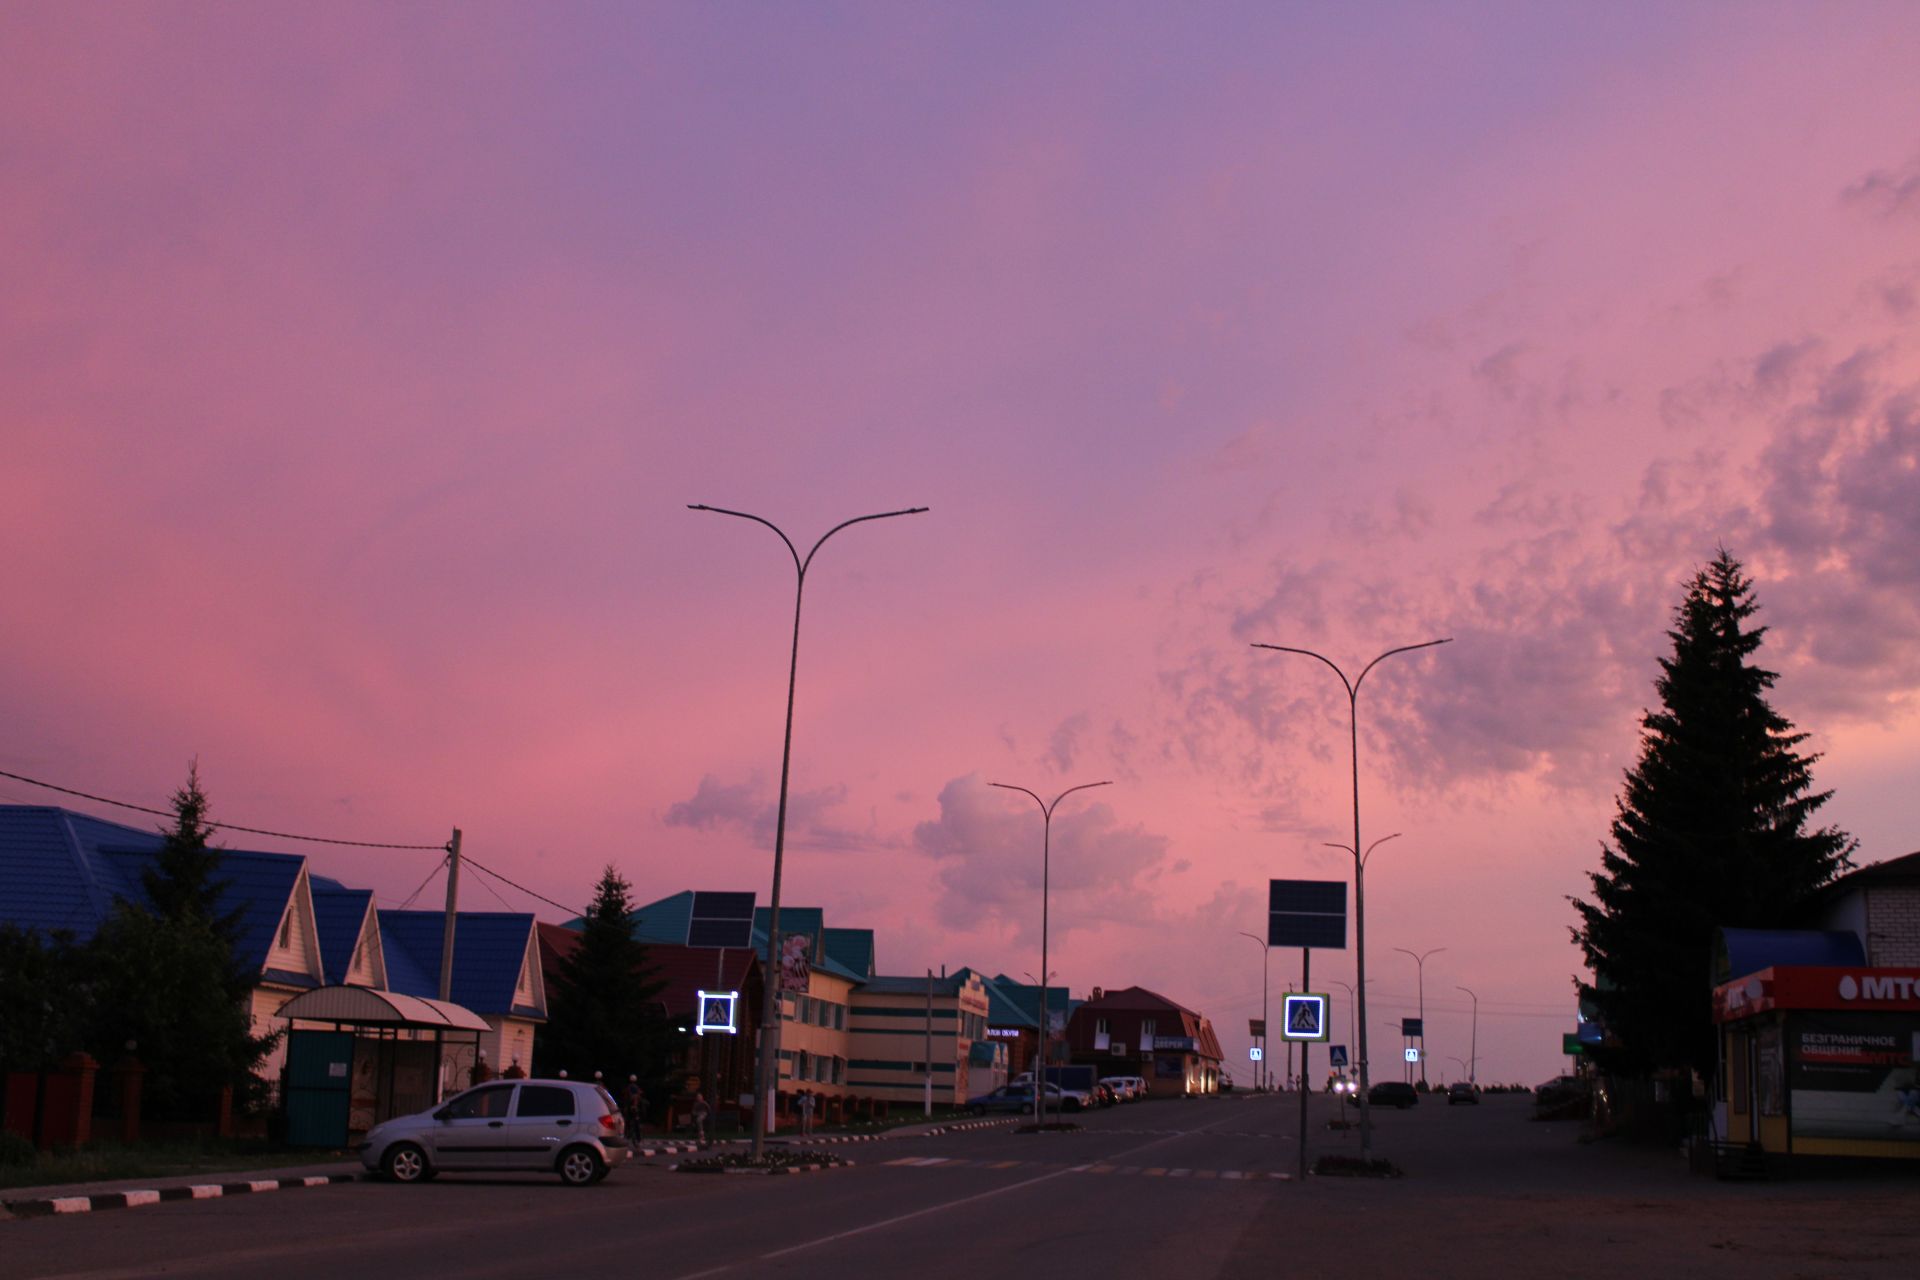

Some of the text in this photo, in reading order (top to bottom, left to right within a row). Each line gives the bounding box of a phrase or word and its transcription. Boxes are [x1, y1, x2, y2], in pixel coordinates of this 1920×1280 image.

[1862, 976, 1920, 1000] МТ
[1801, 1033, 1896, 1047] БЕЗГРАНИЧНОЕ
[1801, 1044, 1863, 1057] ОБЩЕНИЕ
